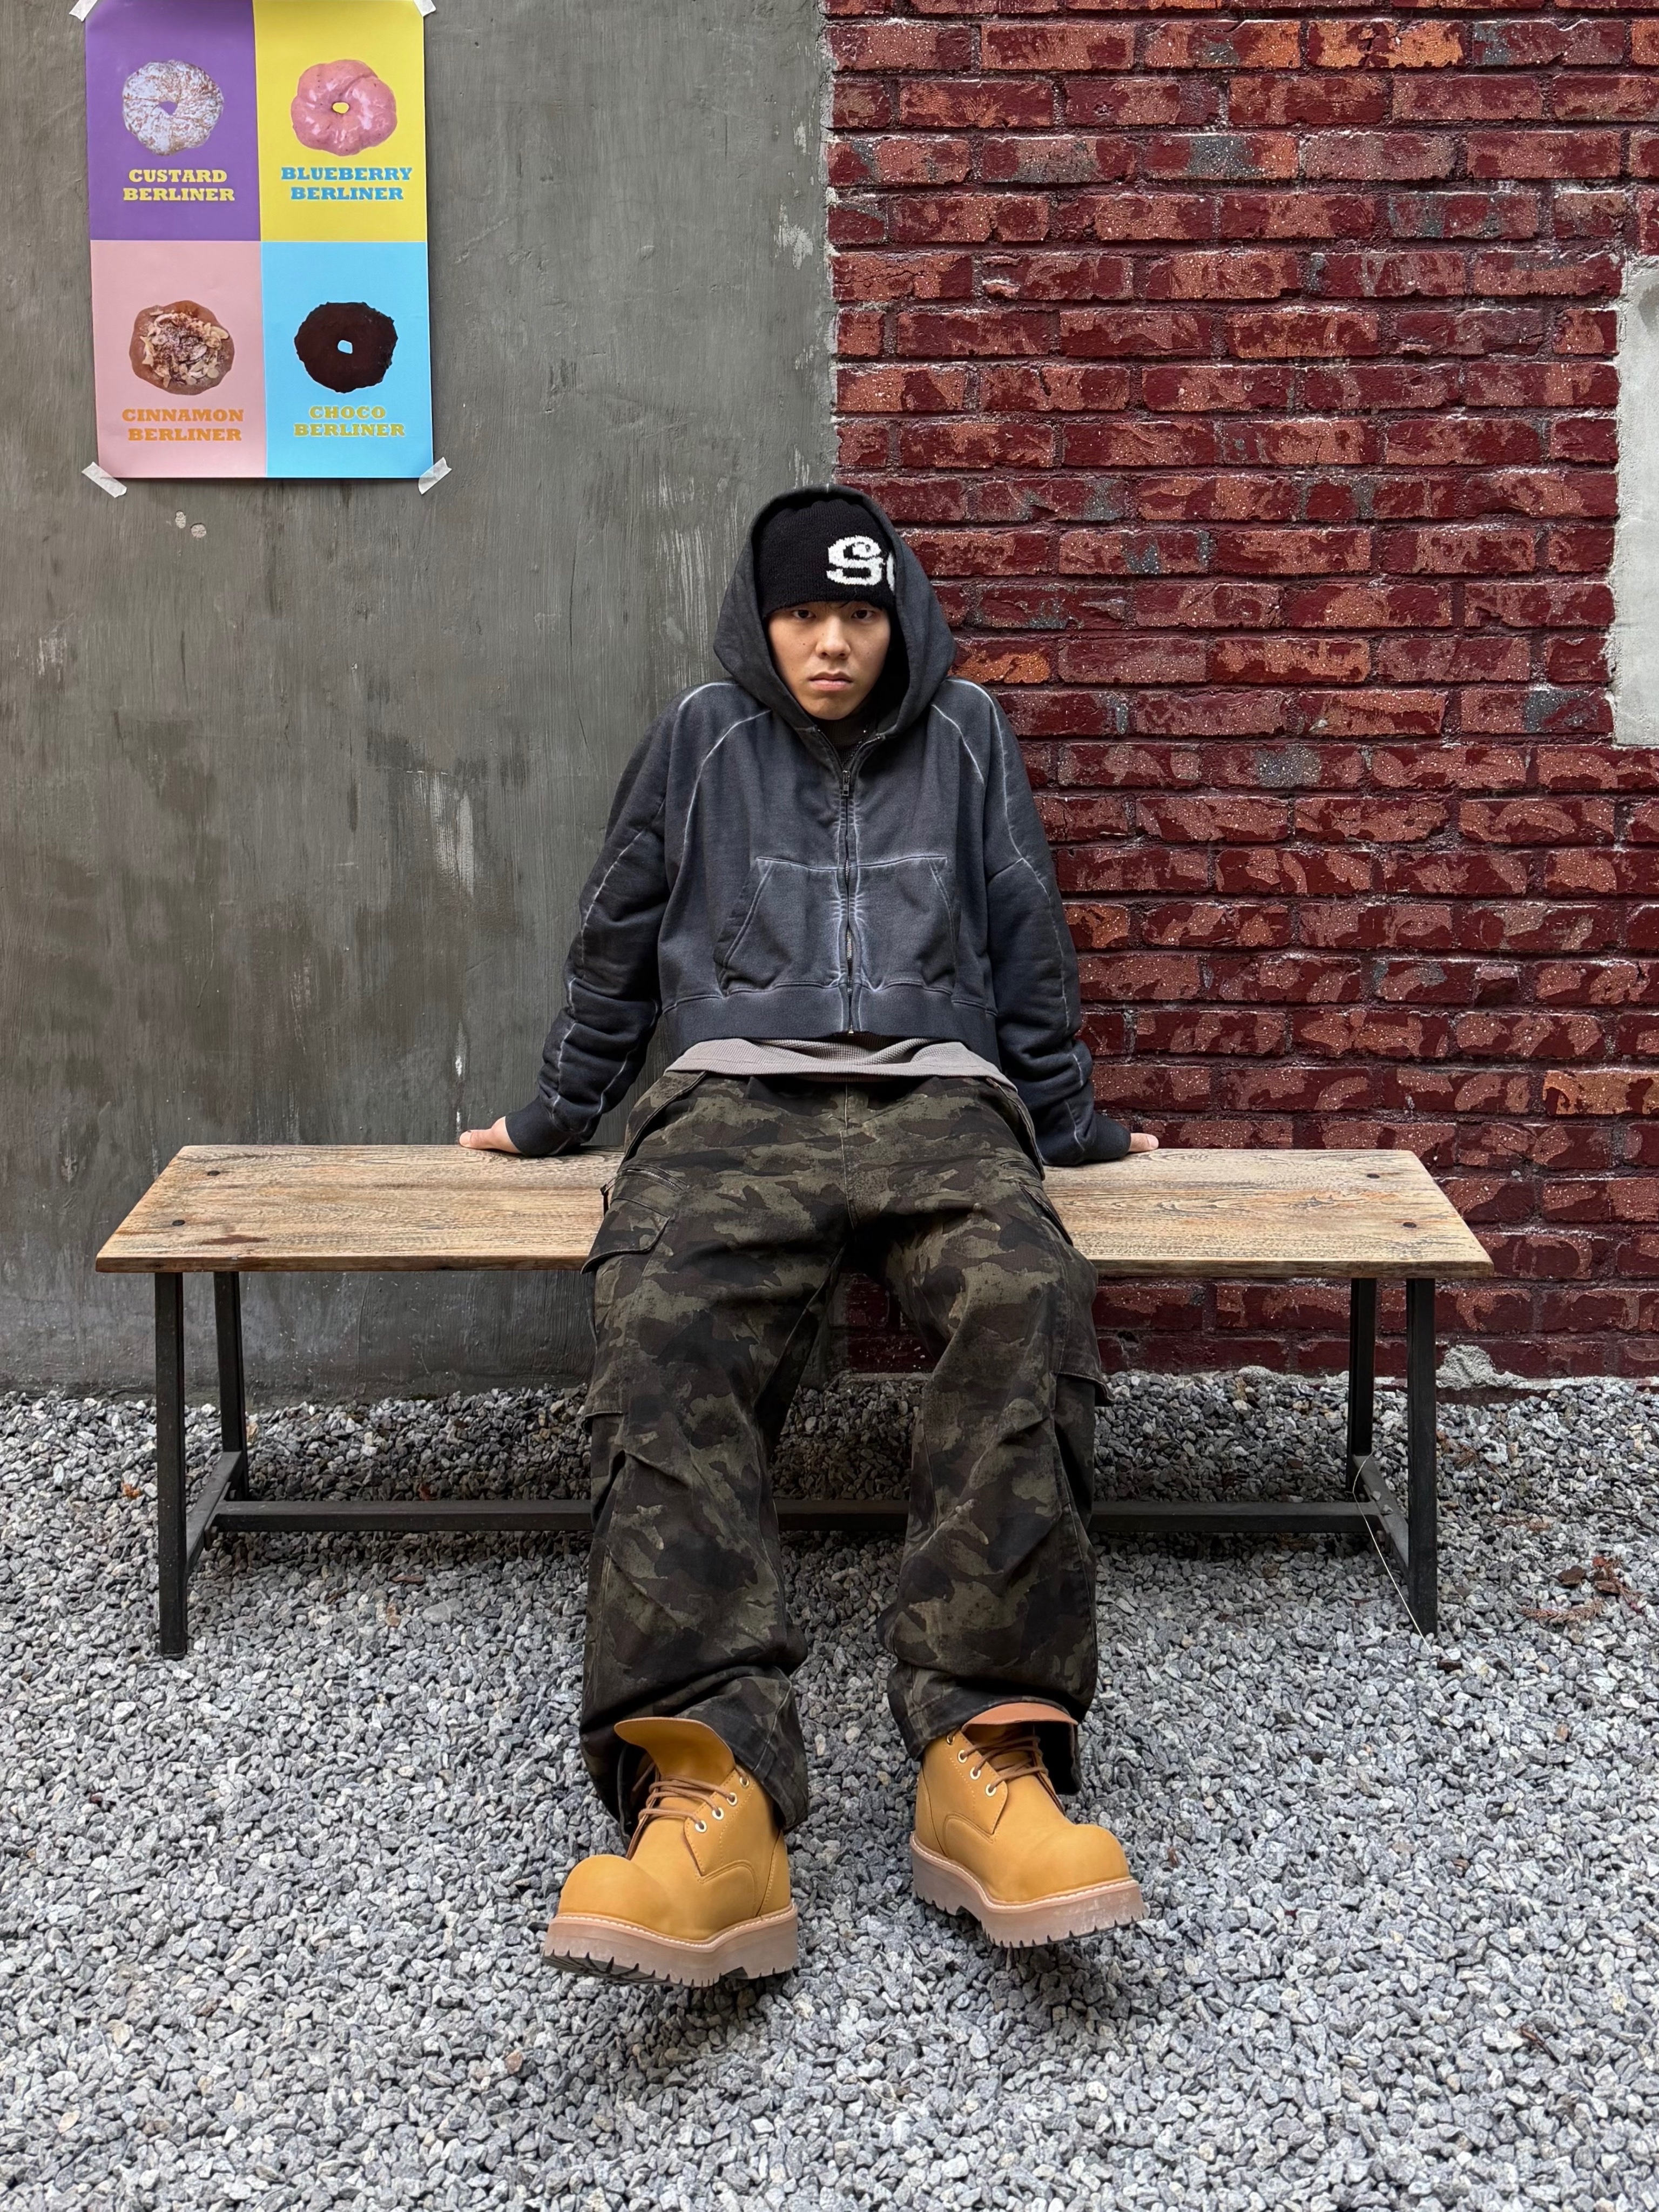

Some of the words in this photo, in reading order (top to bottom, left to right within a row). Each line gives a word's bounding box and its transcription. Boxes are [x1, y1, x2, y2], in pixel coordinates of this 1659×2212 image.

[128, 168, 228, 184] CUSTARD
[280, 166, 413, 181] BLUEBERRY
[123, 187, 235, 202] BERLINER
[290, 186, 404, 201] BERLINER
[122, 408, 244, 422] CINNAMON
[309, 406, 386, 420] CHOCO
[127, 428, 242, 442] BERLINER
[293, 422, 405, 437] BERLINER
